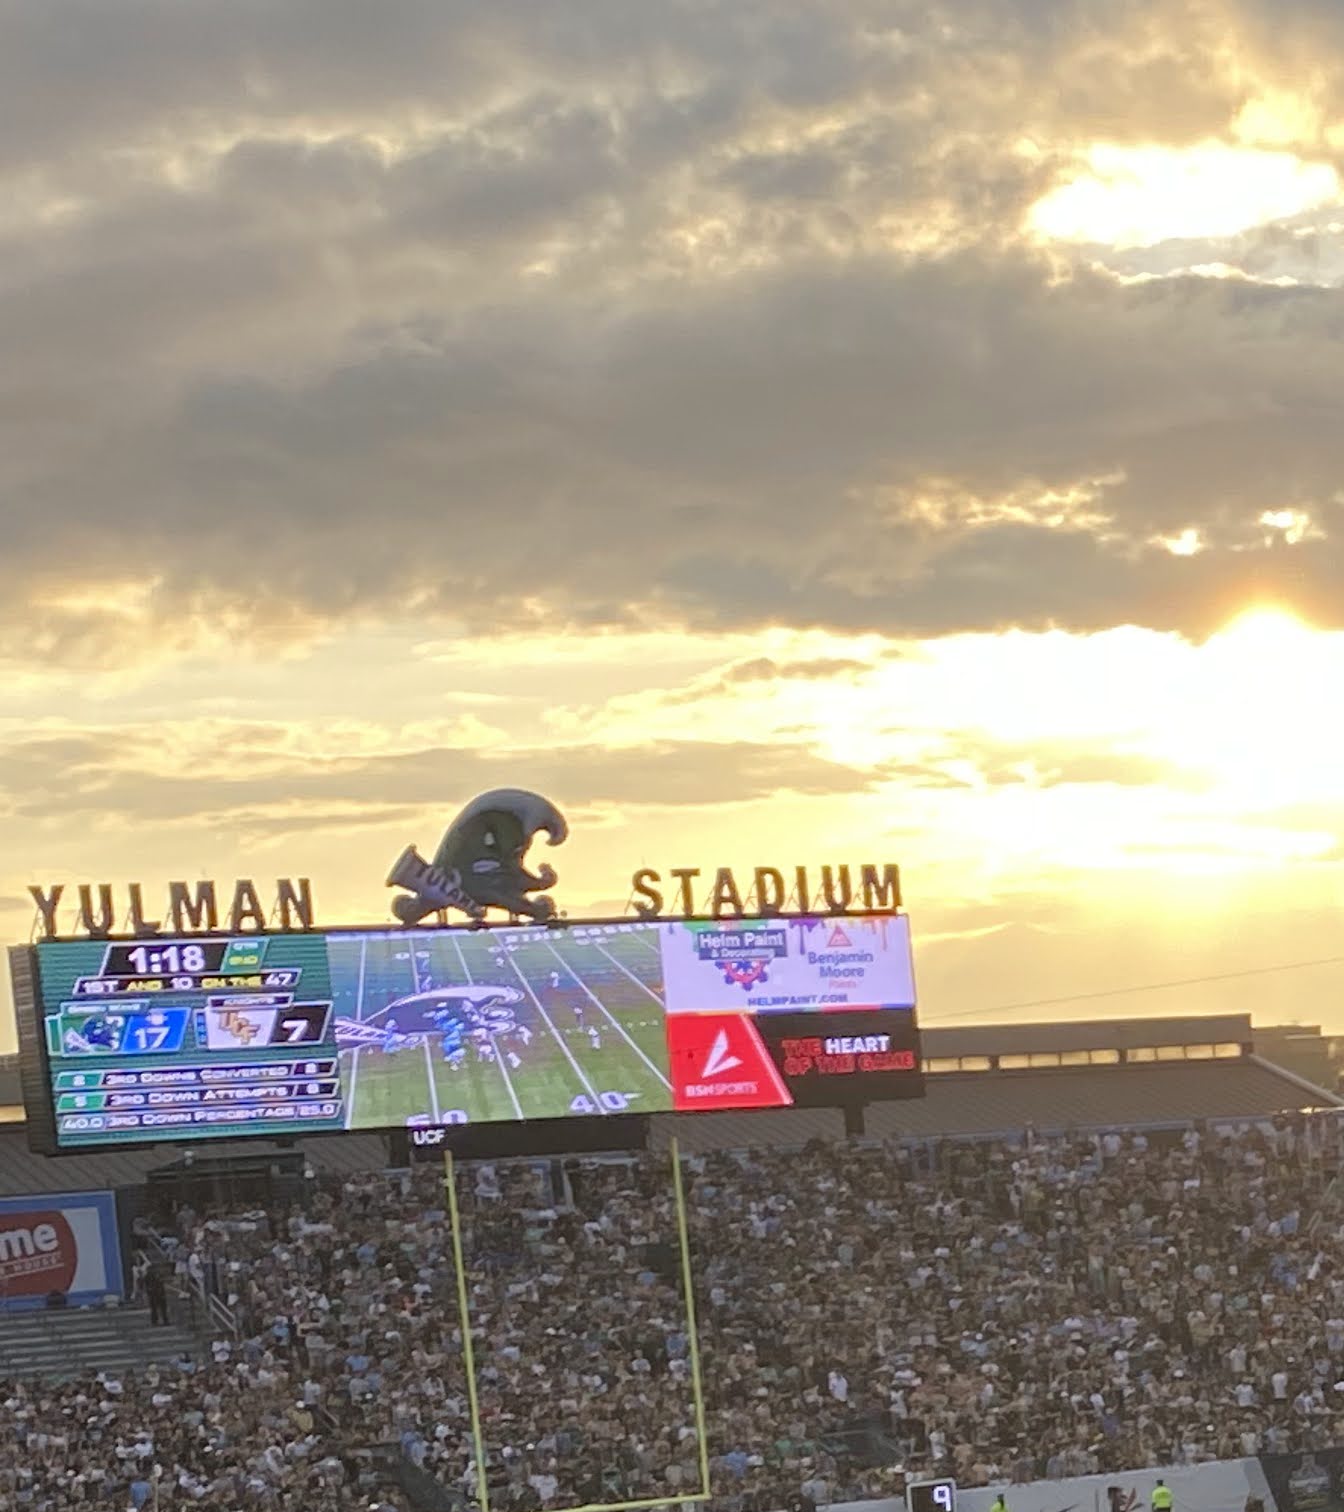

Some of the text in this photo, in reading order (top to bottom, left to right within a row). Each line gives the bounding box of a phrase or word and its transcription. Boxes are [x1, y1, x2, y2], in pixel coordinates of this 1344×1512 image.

[632, 864, 903, 918] STADIUM
[27, 878, 313, 941] YULMAN
[700, 932, 784, 948] Helm Paint
[128, 946, 206, 973] 1:18
[808, 951, 874, 966] Benjamin
[84, 979, 118, 993] 1ST
[127, 979, 162, 991] AND
[170, 977, 193, 990] 10
[265, 973, 292, 986] 47
[820, 967, 865, 978] Moore
[134, 1027, 170, 1049] 17
[282, 1020, 308, 1042] 7
[825, 1035, 890, 1054] HEART
[413, 1130, 445, 1145] UCF
[933, 1486, 951, 1512] 9
